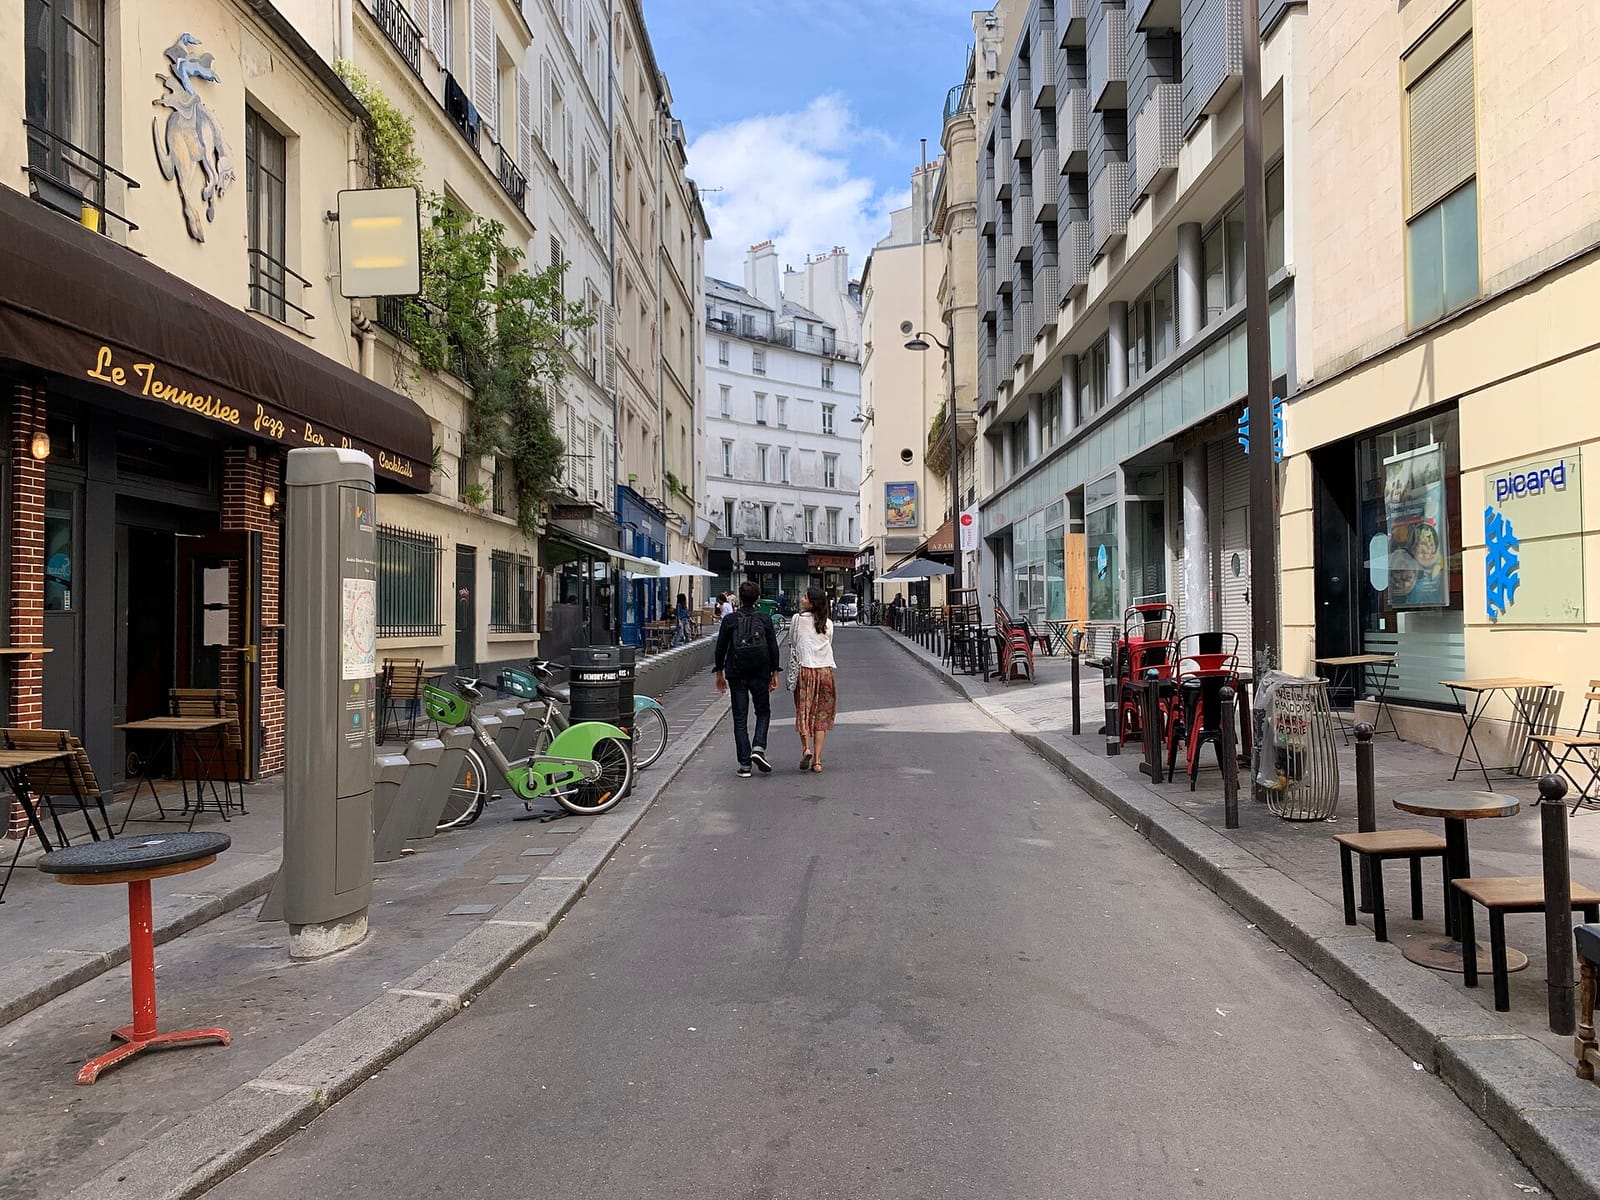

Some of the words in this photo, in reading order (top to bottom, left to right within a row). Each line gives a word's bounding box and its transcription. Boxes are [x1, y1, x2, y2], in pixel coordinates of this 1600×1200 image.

[86, 345, 127, 386] Le
[133, 362, 241, 425] Tennessee
[253, 402, 285, 439] Jazz
[303, 422, 325, 447] Bar
[378, 450, 413, 478] Cocktails
[1496, 459, 1564, 502] picard
